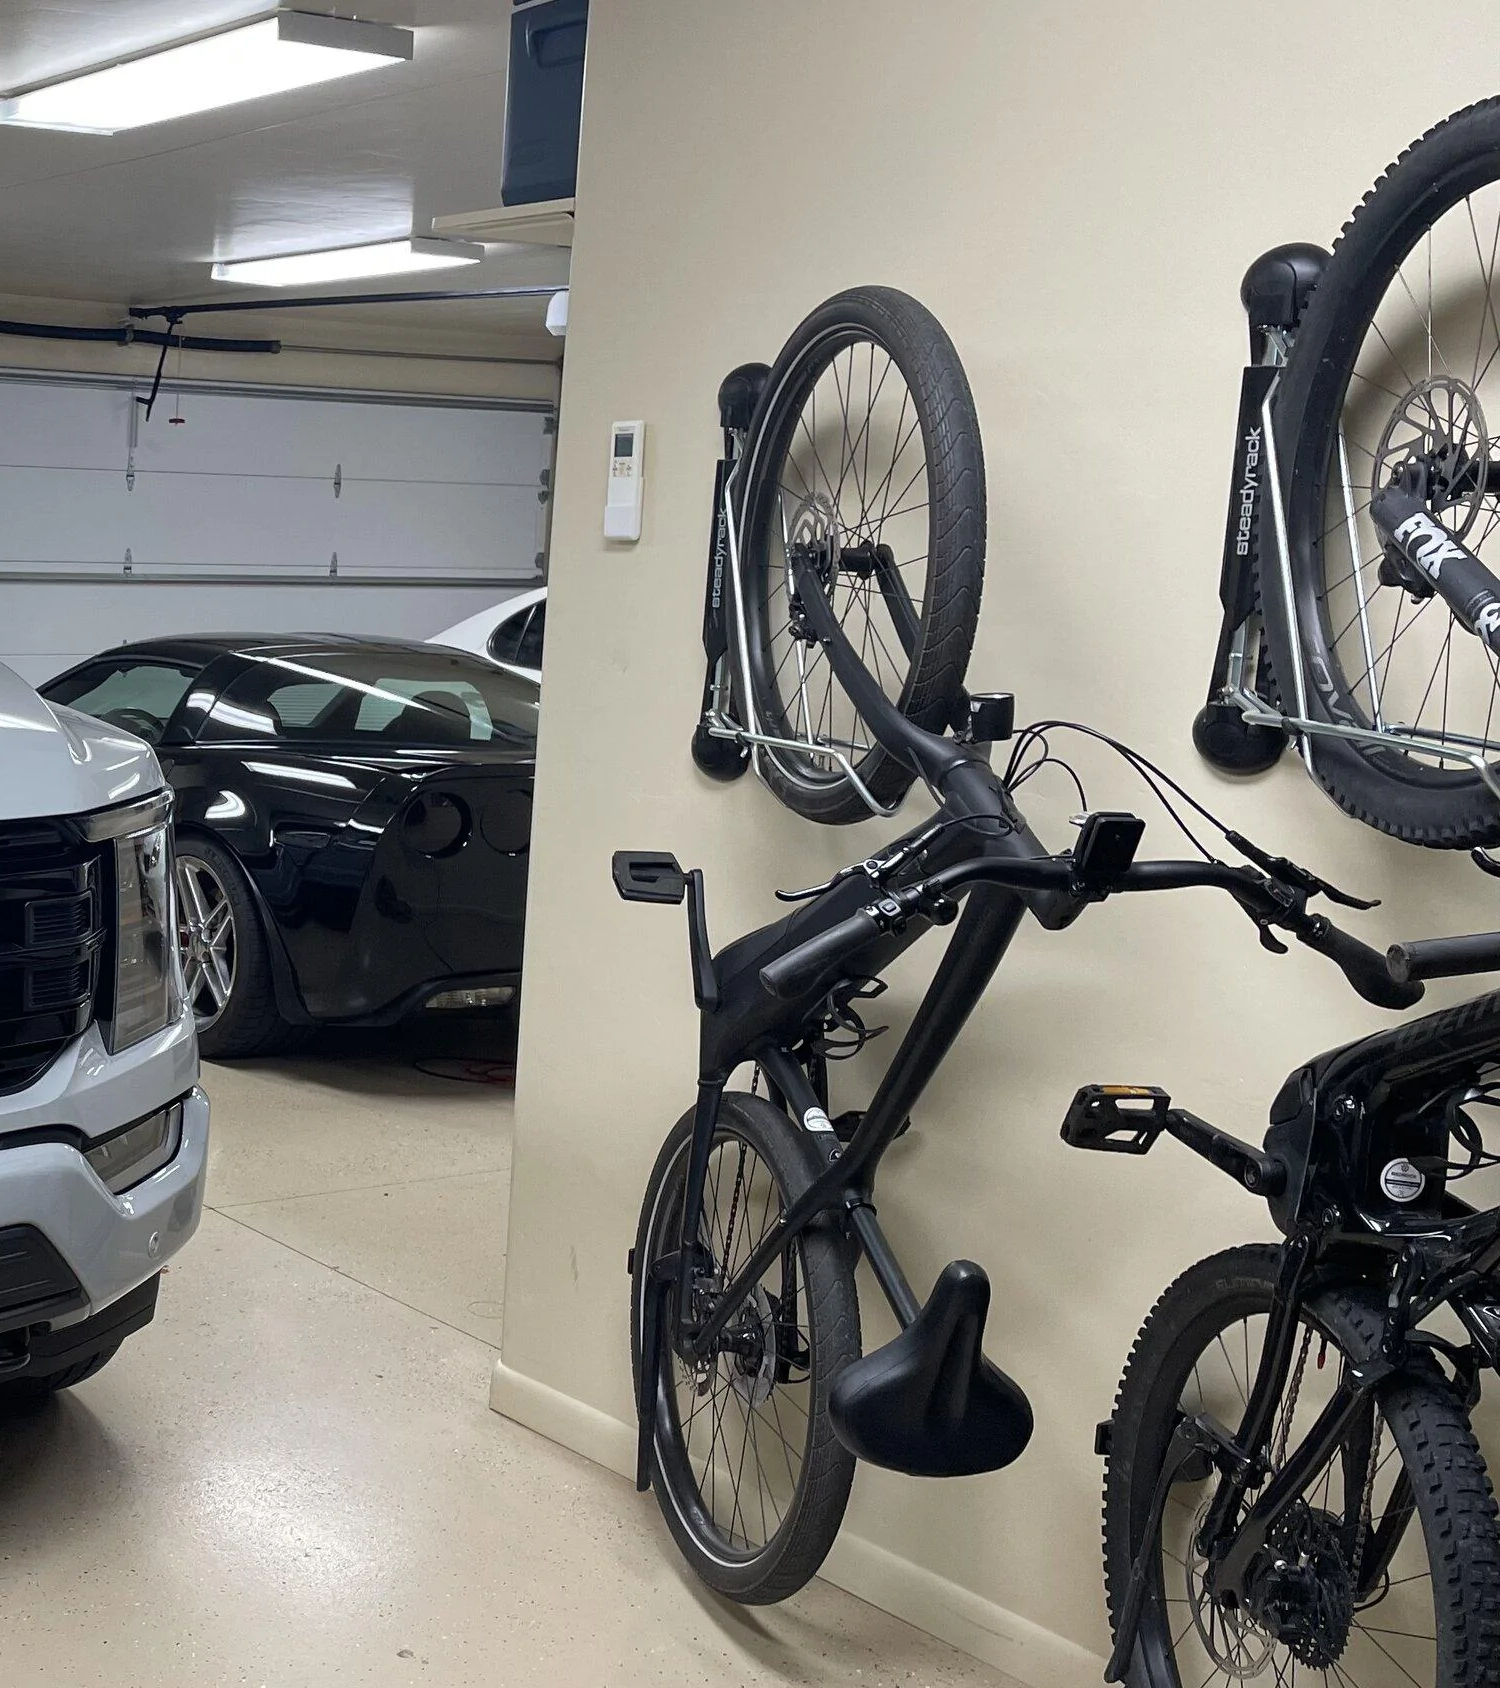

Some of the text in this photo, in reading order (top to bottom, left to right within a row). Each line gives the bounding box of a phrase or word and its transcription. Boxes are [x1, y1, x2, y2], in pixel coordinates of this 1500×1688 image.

[1236, 426, 1262, 556] steadyrack
[712, 507, 728, 609] steadyrack
[1394, 511, 1468, 580] FOX
